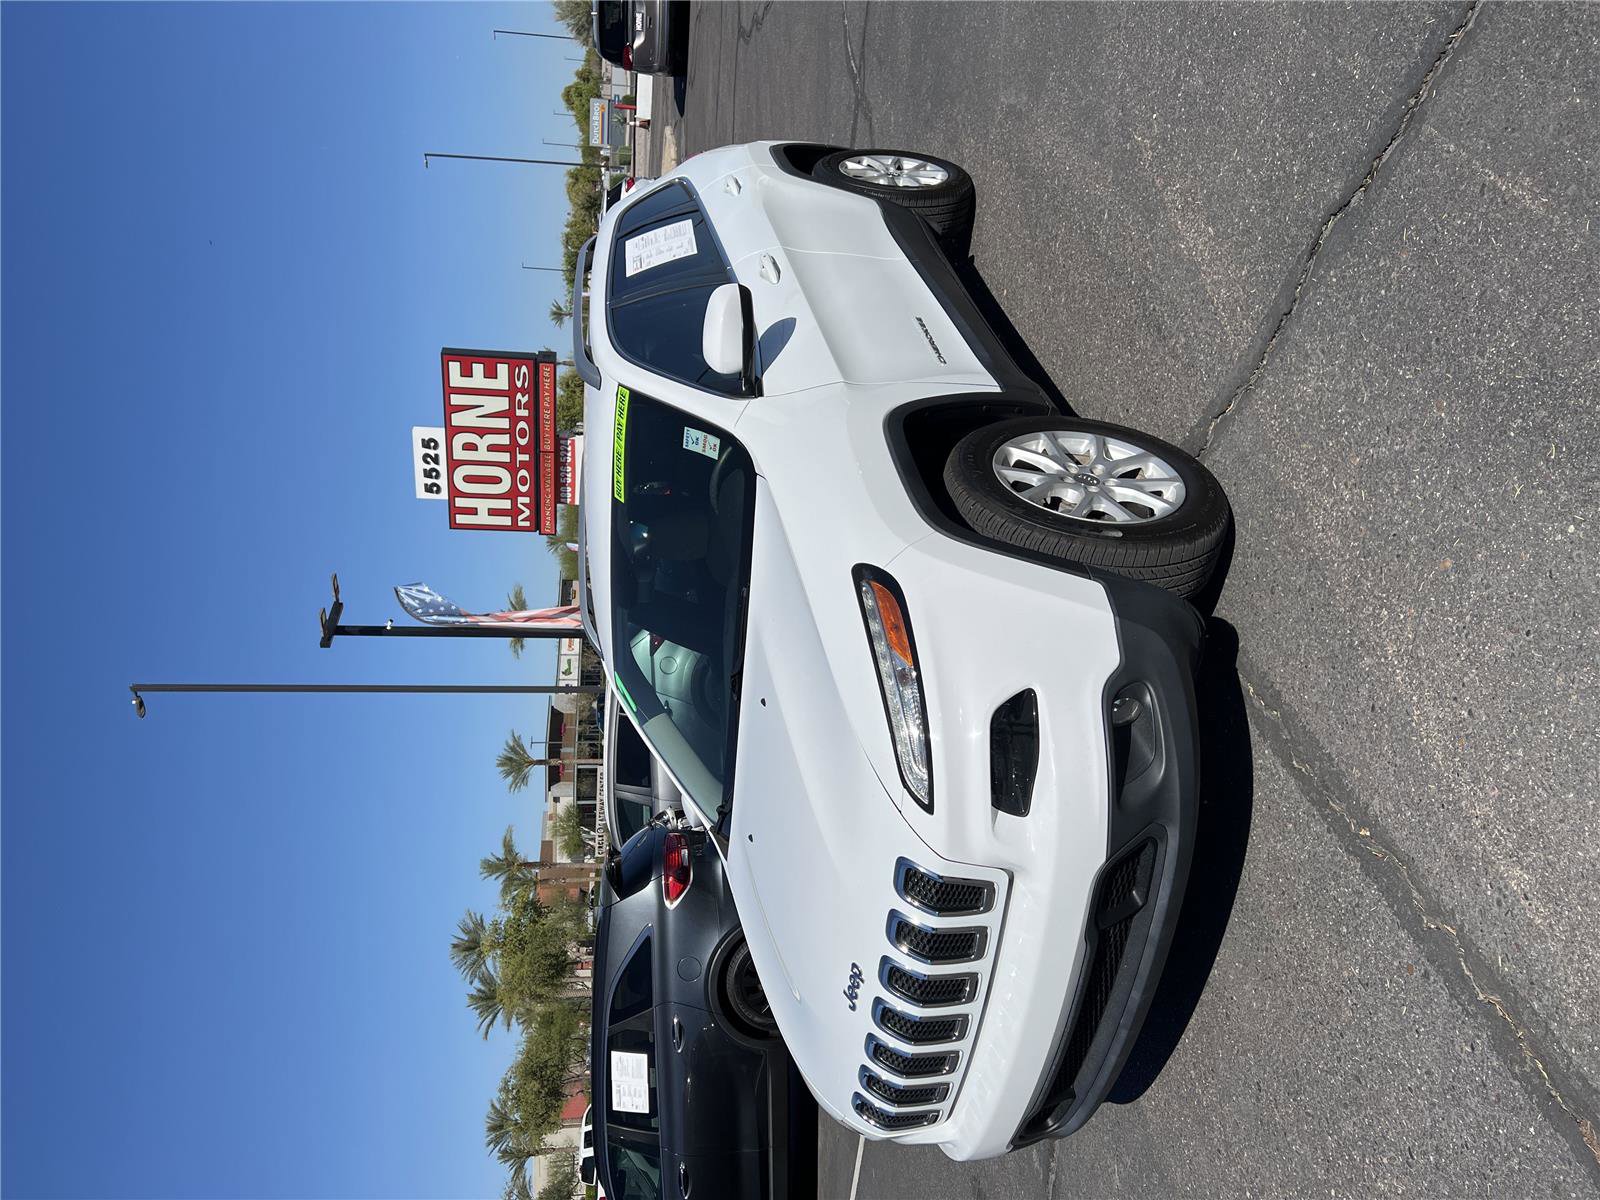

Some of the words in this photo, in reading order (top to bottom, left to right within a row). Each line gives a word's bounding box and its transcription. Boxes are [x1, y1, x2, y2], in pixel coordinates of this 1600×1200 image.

[915, 316, 947, 364] CHEROKEE
[543, 366, 551, 389] HERE
[543, 391, 551, 407] PAY
[618, 390, 627, 419] HERE
[543, 408, 551, 430] HERE
[616, 419, 624, 442] PAY
[448, 361, 513, 526] HORNE
[514, 364, 531, 527] MOTORS
[543, 432, 551, 450] BUY
[695, 436, 700, 446] OK
[712, 443, 717, 452] OK
[421, 437, 442, 495] 5525
[544, 454, 552, 492] AVAILABLE
[544, 494, 552, 533] FINANCING
[842, 962, 864, 1012] Jeep
